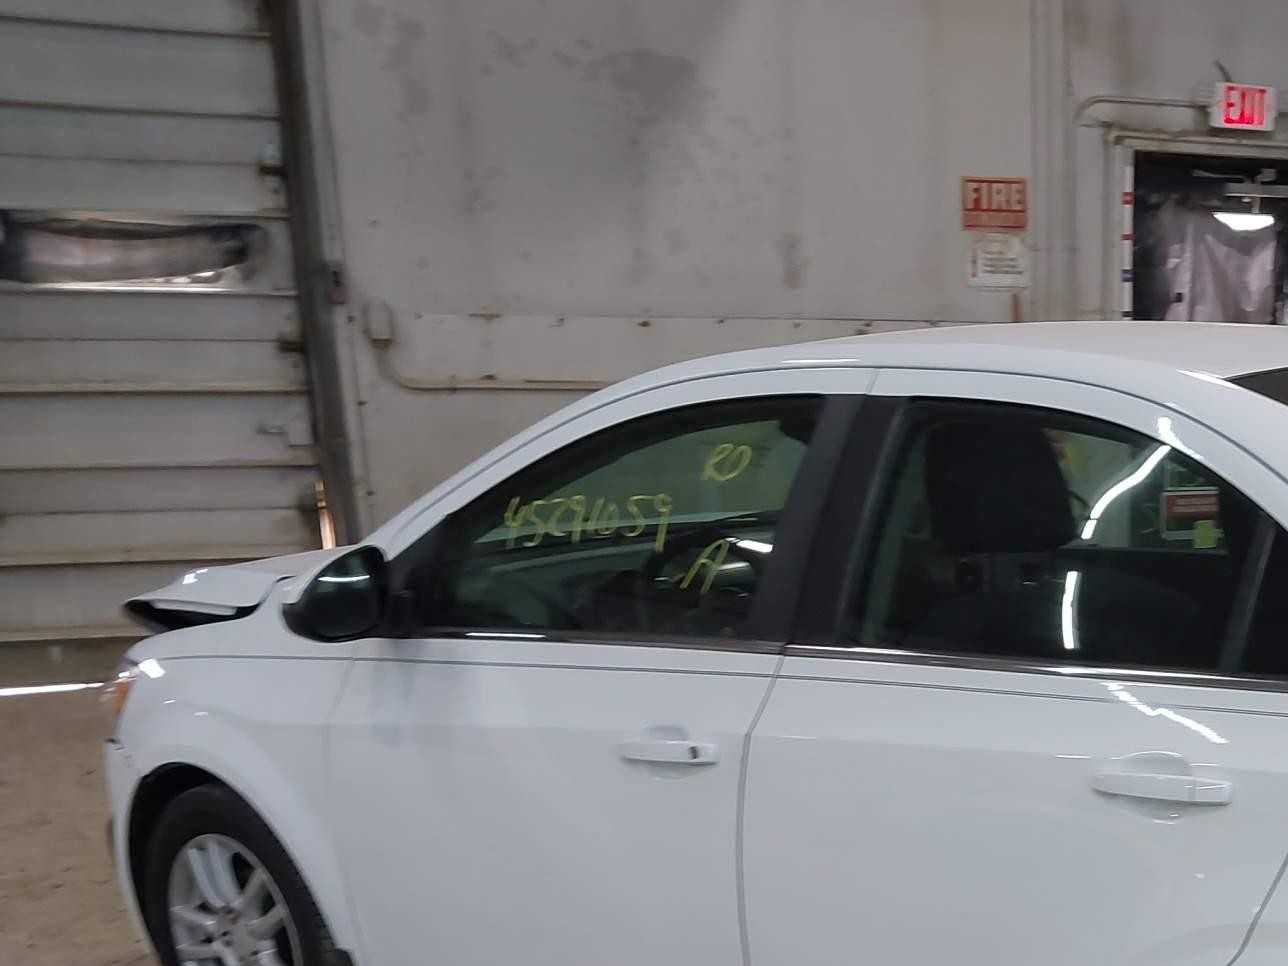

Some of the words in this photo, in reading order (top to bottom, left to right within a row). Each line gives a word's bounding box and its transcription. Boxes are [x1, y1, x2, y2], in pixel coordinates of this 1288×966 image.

[1224, 86, 1266, 126] EXIT
[966, 182, 1025, 209] FIRE
[679, 539, 730, 593] A
